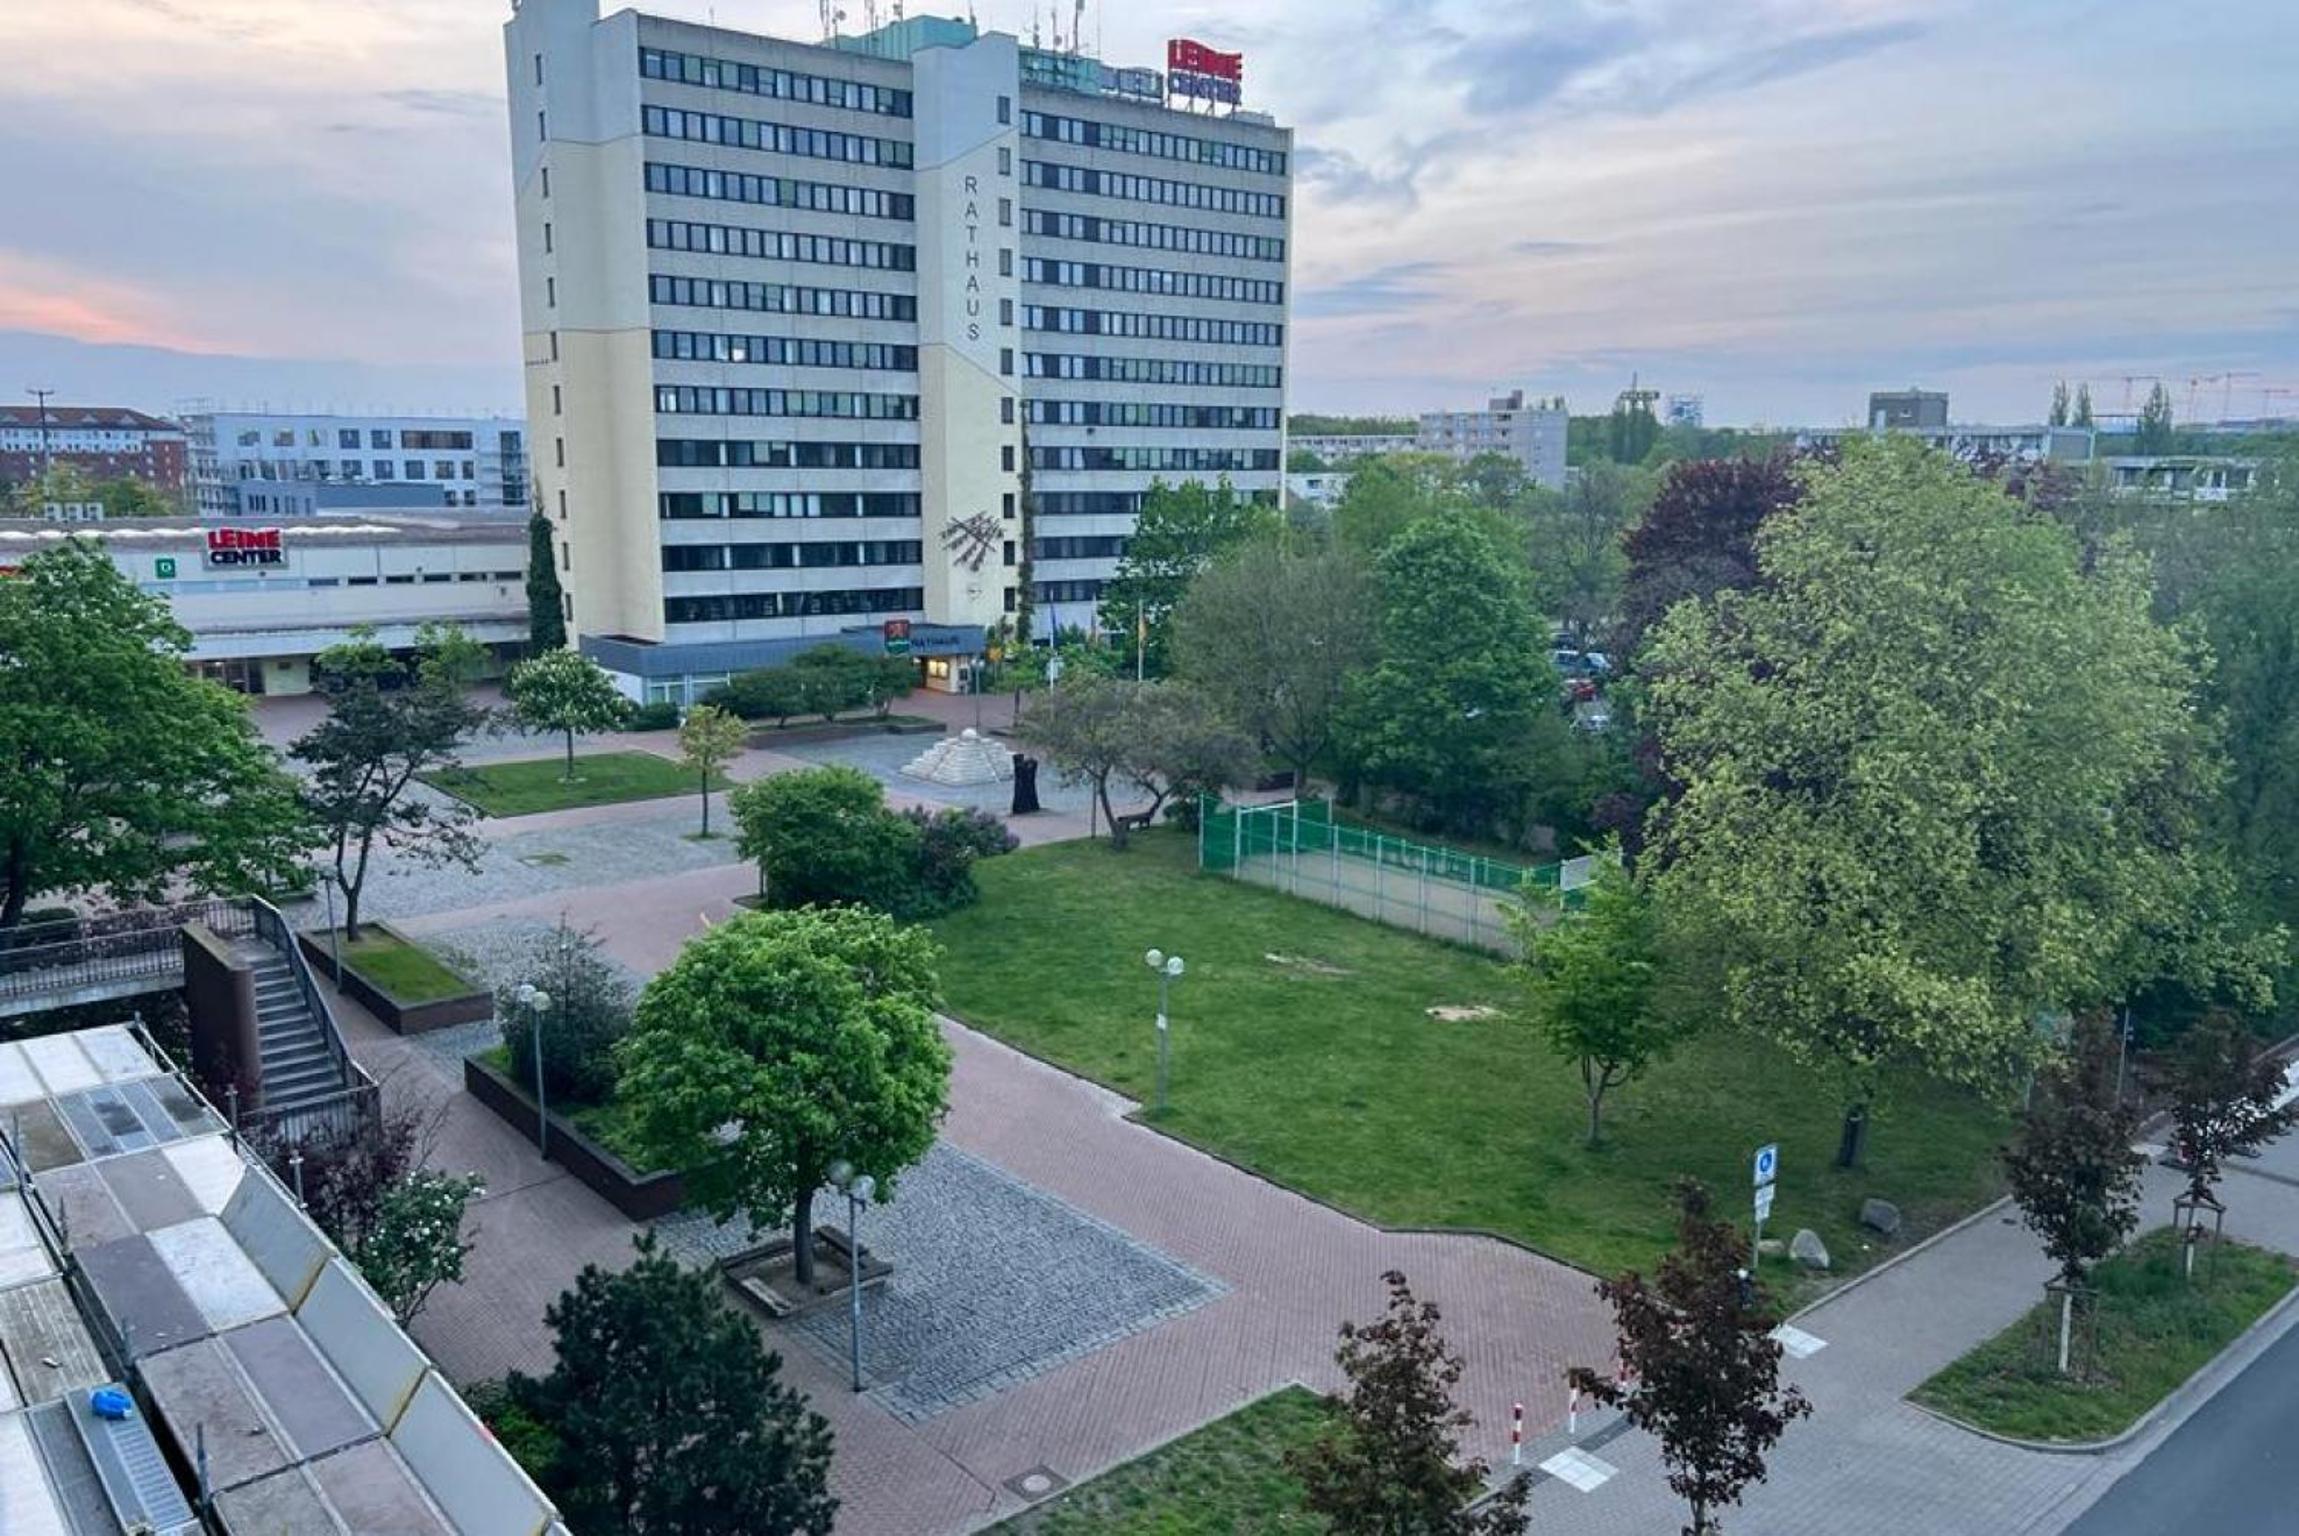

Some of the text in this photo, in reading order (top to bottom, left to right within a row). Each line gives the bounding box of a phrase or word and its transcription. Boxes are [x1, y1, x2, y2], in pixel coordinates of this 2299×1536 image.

[964, 175, 980, 341] RATHAUS
[208, 528, 280, 549] LEINE
[210, 549, 282, 563] CENTER
